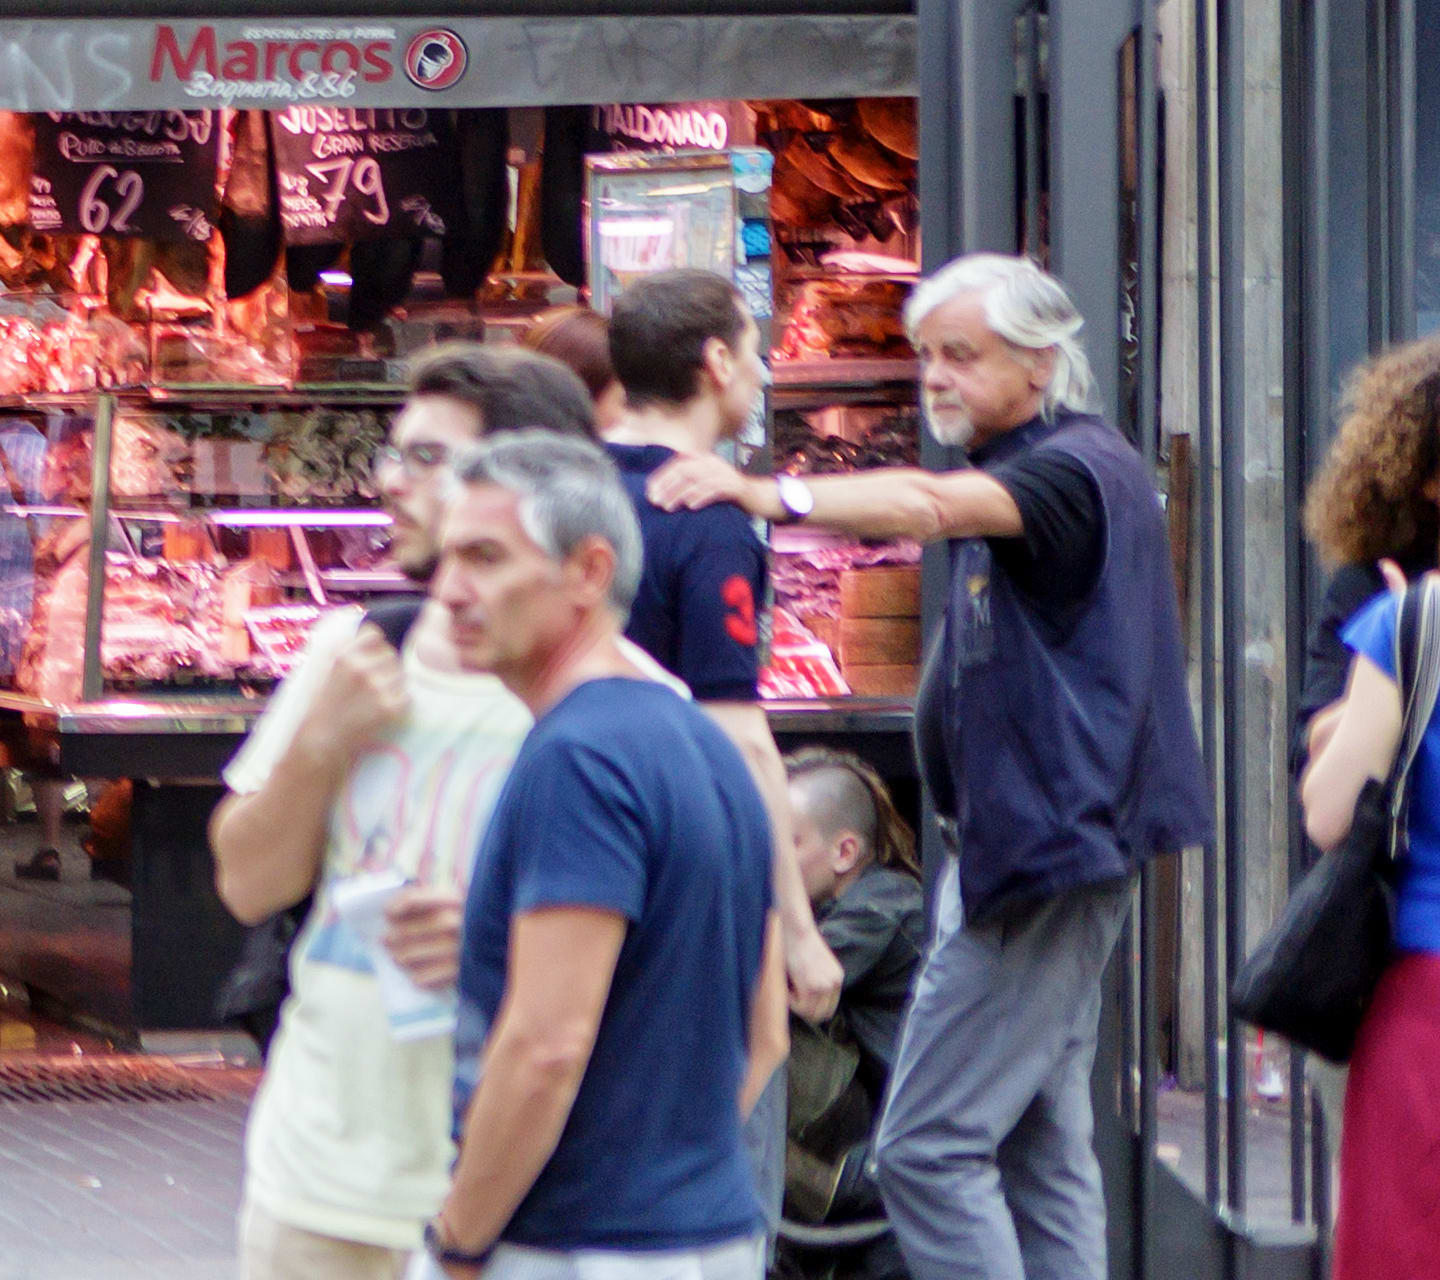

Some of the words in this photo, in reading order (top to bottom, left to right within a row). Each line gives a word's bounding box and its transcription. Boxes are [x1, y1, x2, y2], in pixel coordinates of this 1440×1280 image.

[150, 24, 394, 83] Marcos
[80, 164, 143, 233] 62
[305, 156, 390, 225] 79
